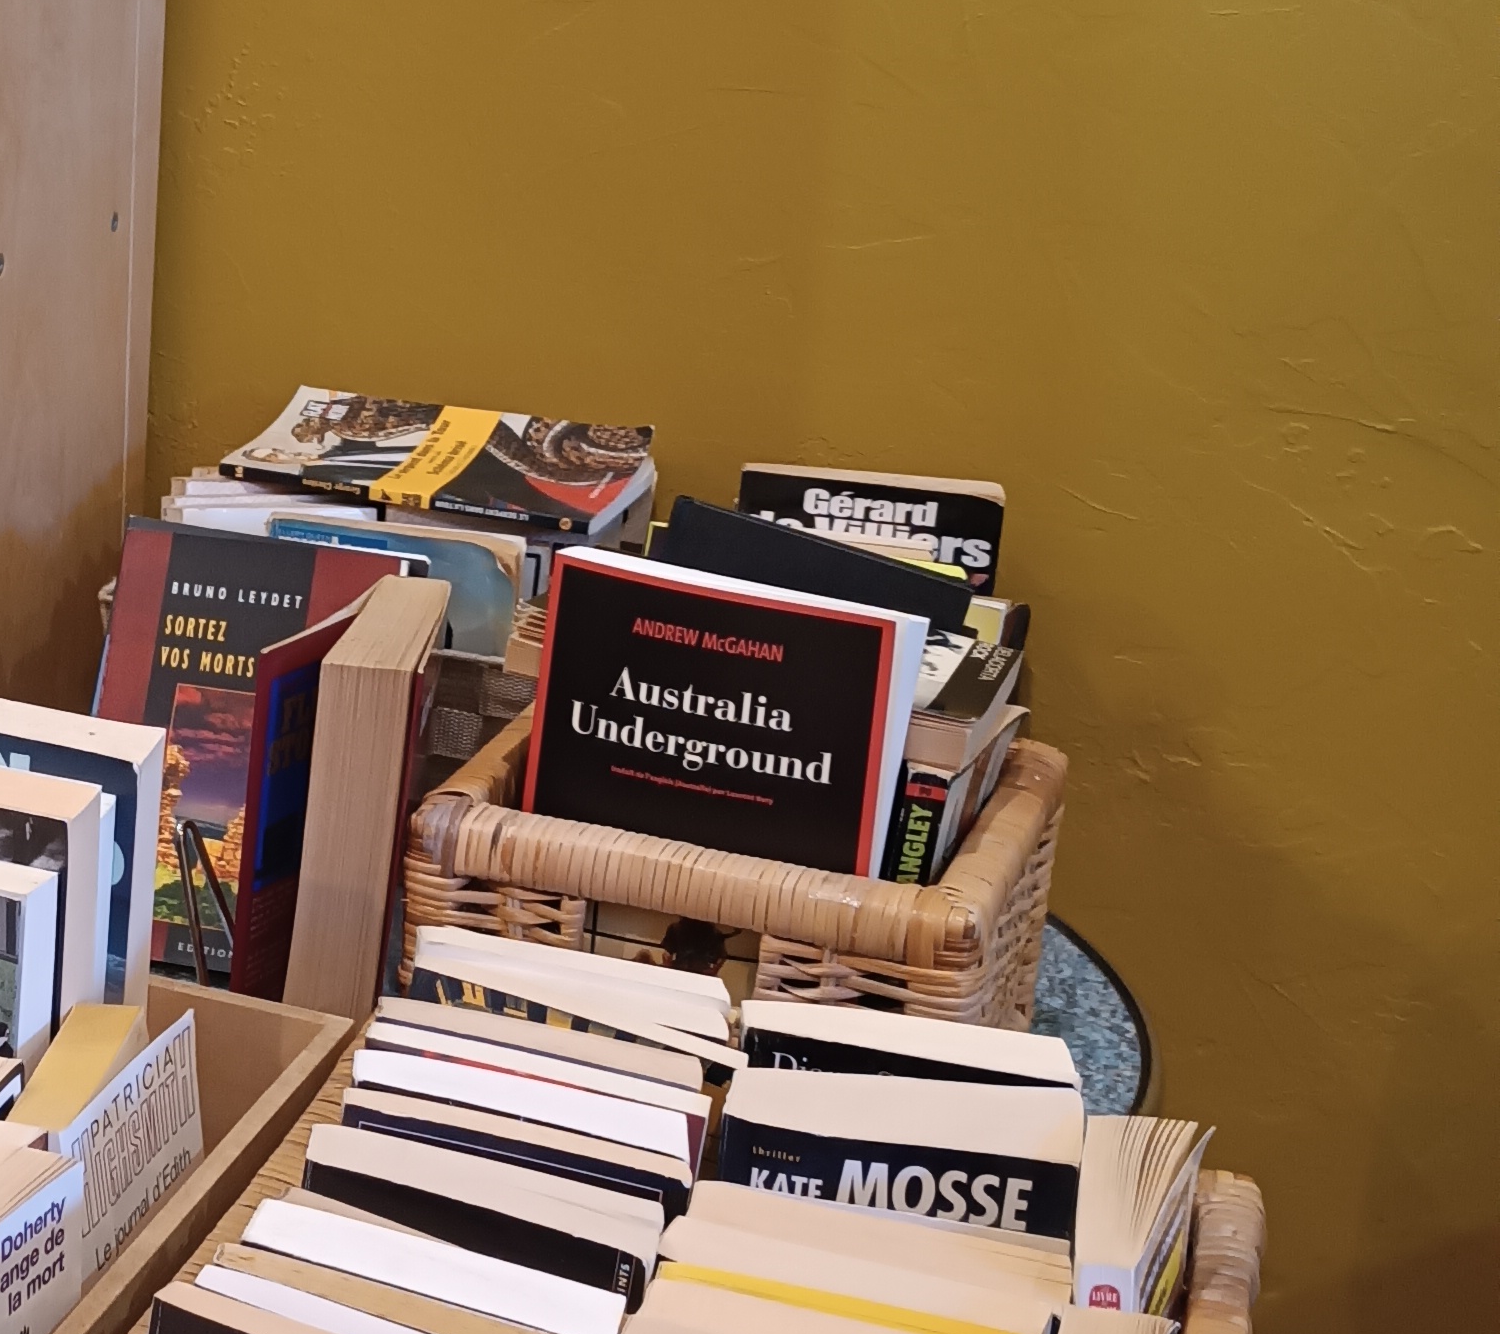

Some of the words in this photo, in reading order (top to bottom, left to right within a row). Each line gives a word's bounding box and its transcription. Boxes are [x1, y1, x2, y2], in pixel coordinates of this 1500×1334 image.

[802, 487, 938, 529] Gérard
[171, 580, 228, 603] BRUNO
[236, 586, 304, 610] LEYDET
[164, 613, 227, 643] SORTEZ
[632, 616, 700, 648] ANDREW
[701, 633, 784, 663] McGAHAN
[160, 644, 190, 671] VOS
[199, 650, 256, 678] MORTS
[609, 665, 793, 734] Australia
[570, 699, 833, 786] Underground
[177, 940, 235, 960] EDTION
[89, 1044, 176, 1148] PATRICIA
[71, 1025, 196, 1239] HIGHSMITH
[94, 1243, 112, 1272] Le
[114, 1194, 152, 1267] journal
[150, 1148, 192, 1210] d'Edith
[749, 1166, 824, 1200] KATE
[835, 1158, 1034, 1233] MOSSE
[1, 1196, 67, 1259] Doherty
[43, 1227, 66, 1261] de
[7, 1288, 22, 1316] la
[24, 1252, 66, 1300] mort
